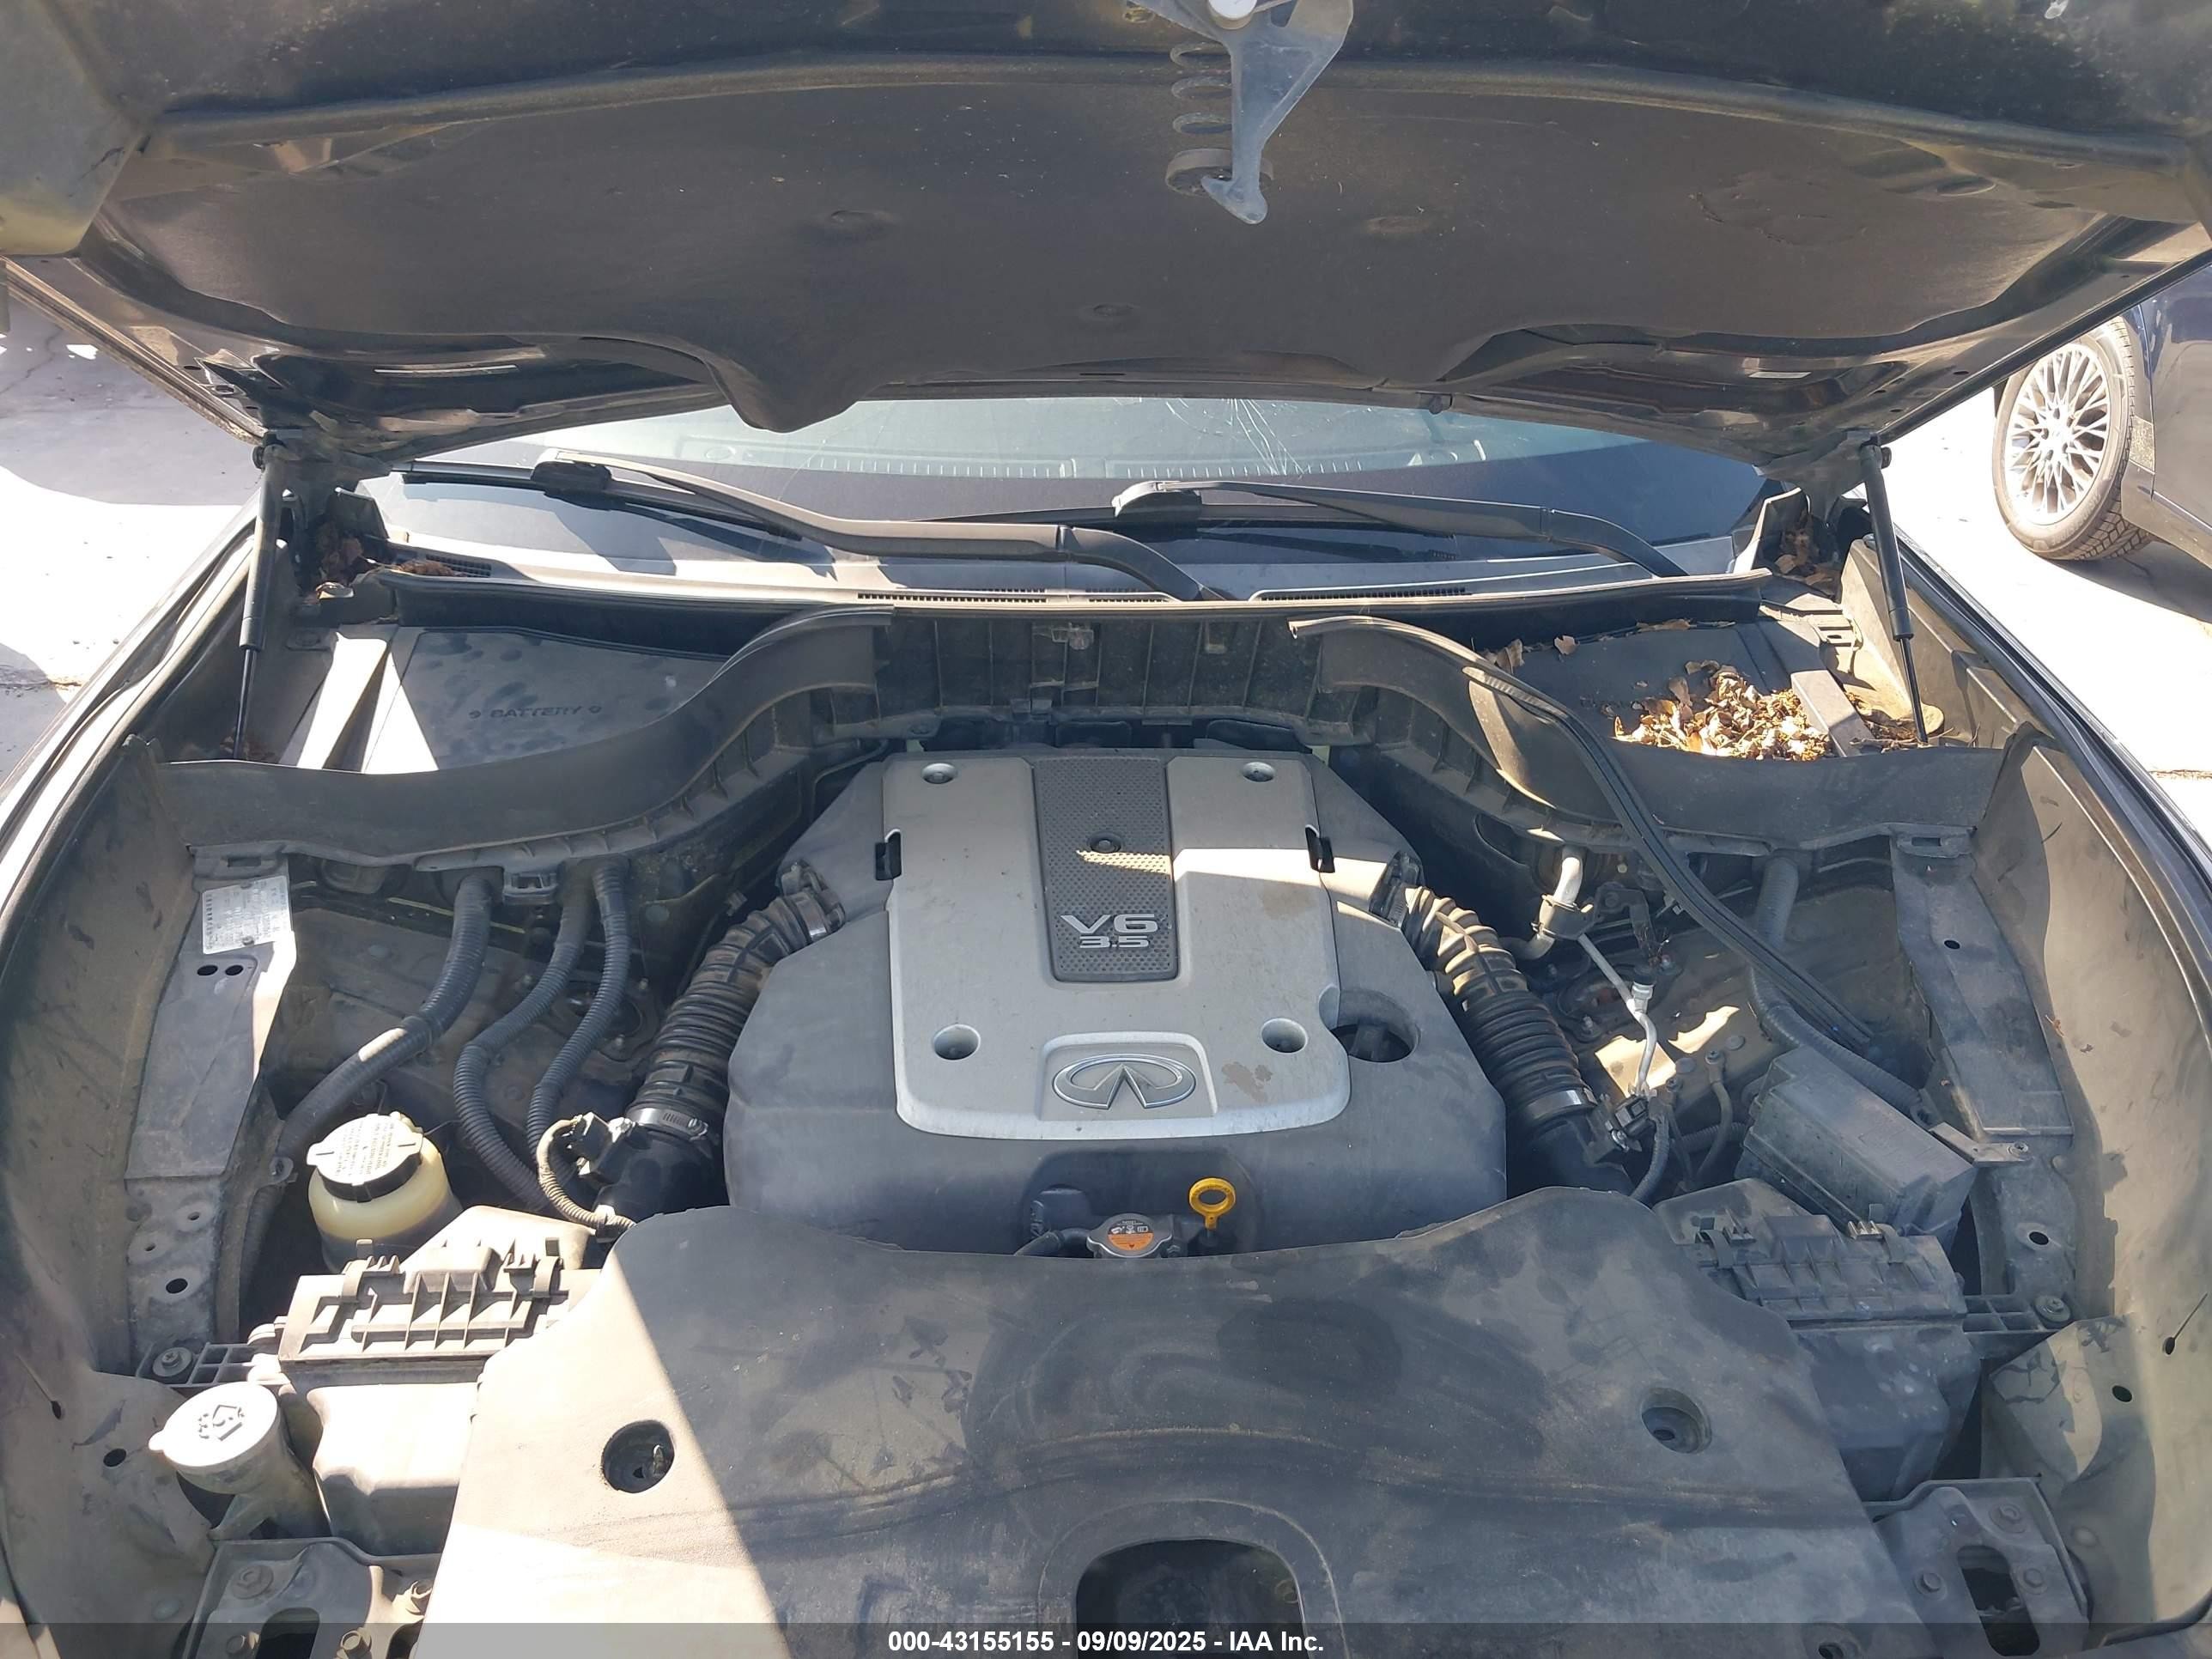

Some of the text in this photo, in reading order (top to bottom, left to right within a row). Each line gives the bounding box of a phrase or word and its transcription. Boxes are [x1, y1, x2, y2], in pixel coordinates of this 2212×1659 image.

[490, 706, 583, 718] BATTERY
[1060, 914, 1158, 933] V6
[1079, 935, 1149, 948] 3.5
